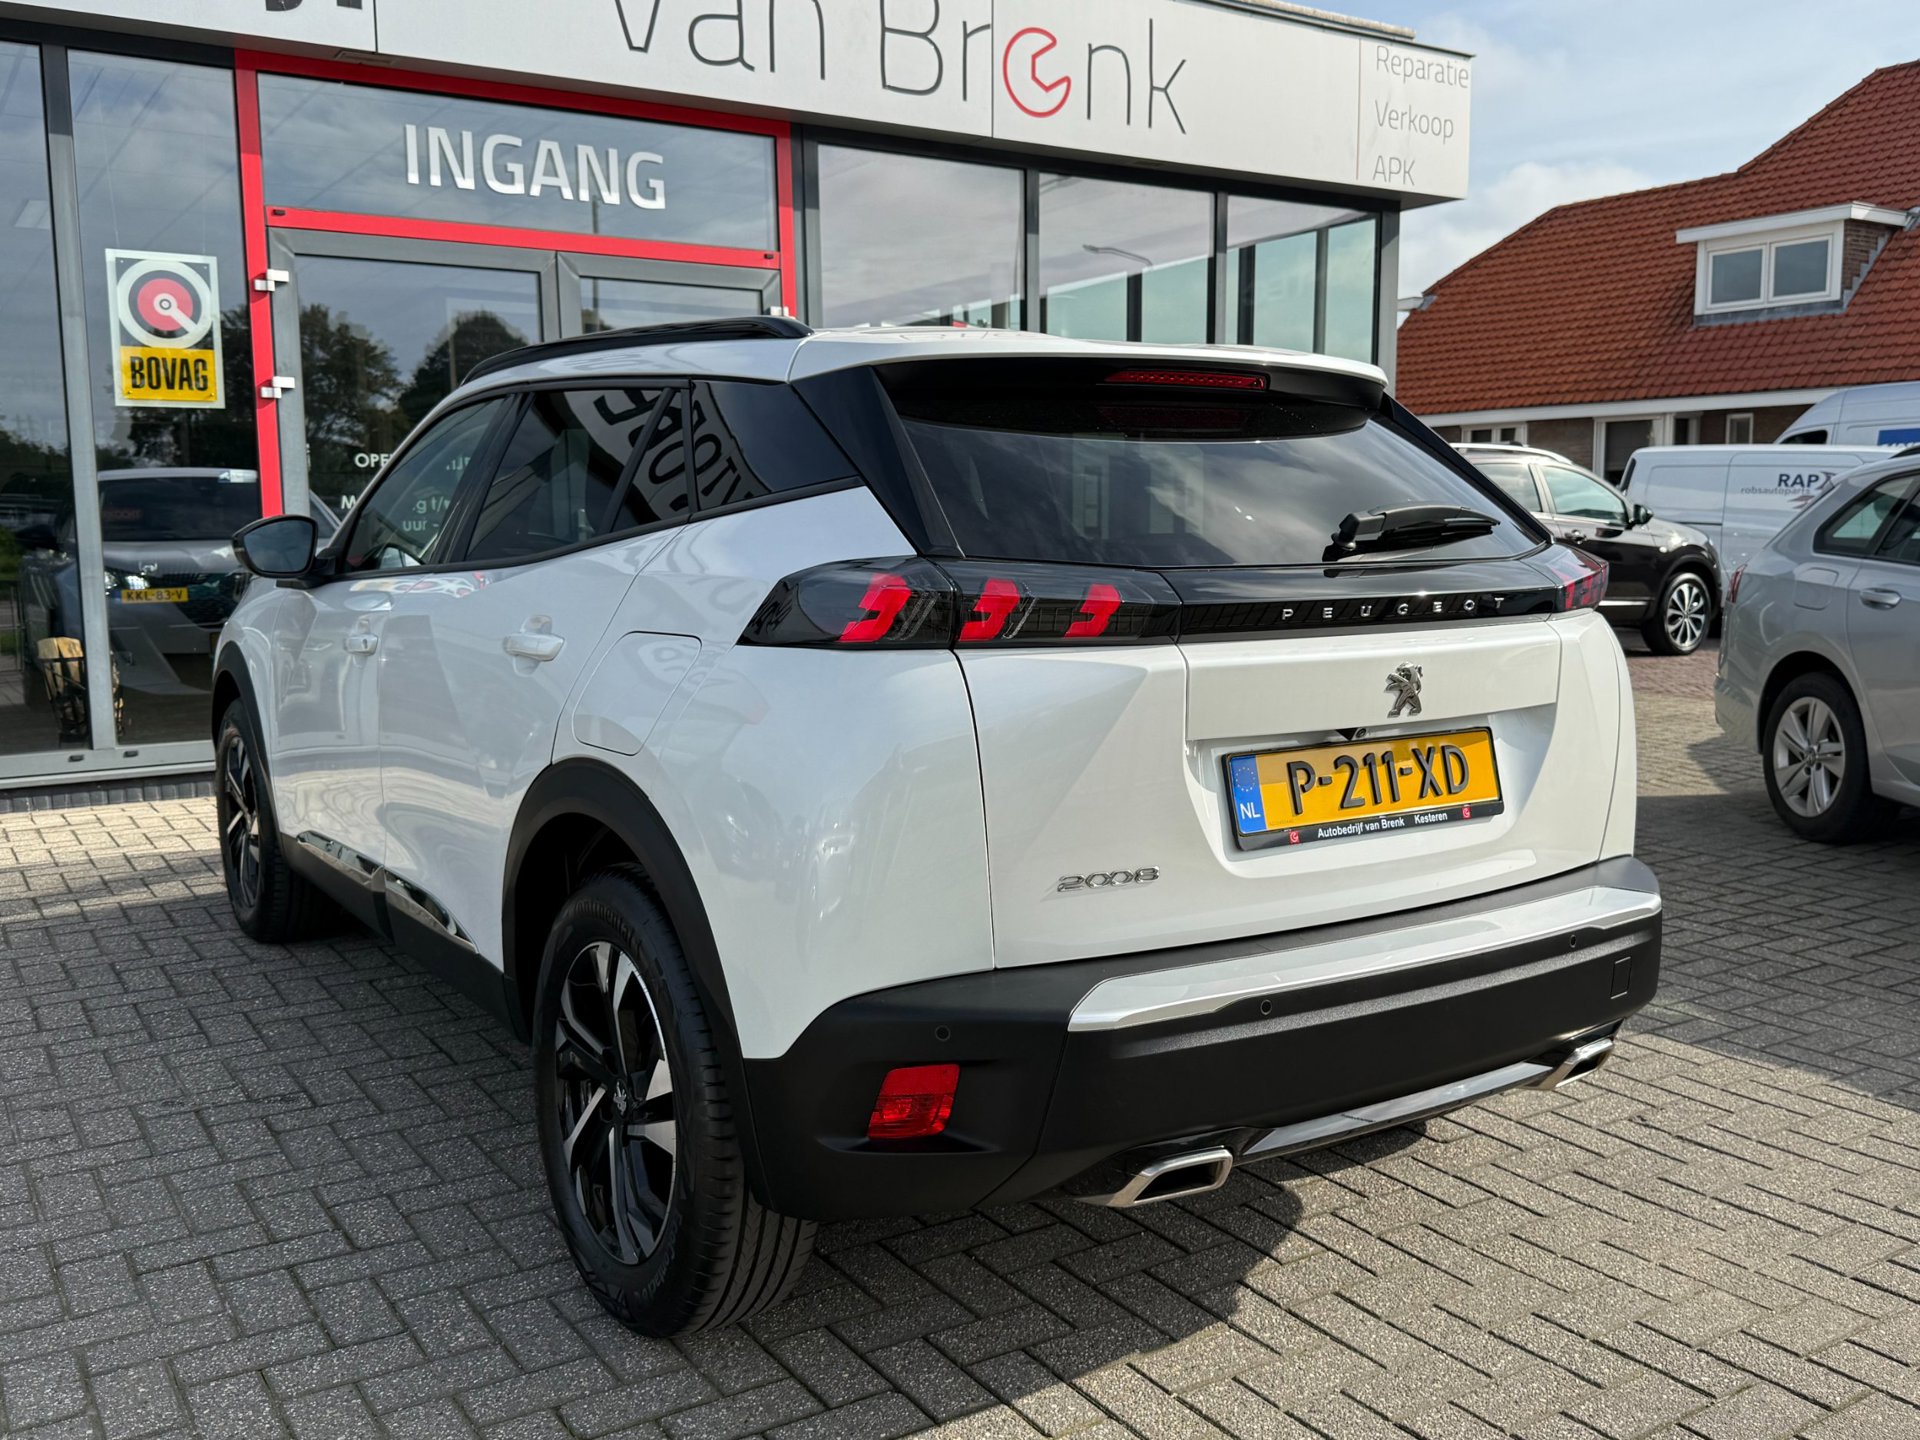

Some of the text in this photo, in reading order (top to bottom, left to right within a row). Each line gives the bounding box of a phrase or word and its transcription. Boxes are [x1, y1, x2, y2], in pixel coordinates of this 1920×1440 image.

[1376, 45, 1469, 88] Reparatie
[1375, 100, 1454, 144] Verkoop
[404, 123, 666, 211] INGANG
[1372, 155, 1416, 186] APK
[130, 356, 208, 391] BOVAG
[1281, 596, 1505, 620] PEUGEOT
[1286, 744, 1470, 816] P-211-XD
[1239, 802, 1262, 820] NL
[1317, 811, 1448, 839] Autobedrijf van Brenk Kesteren
[1057, 866, 1160, 892] 2008
